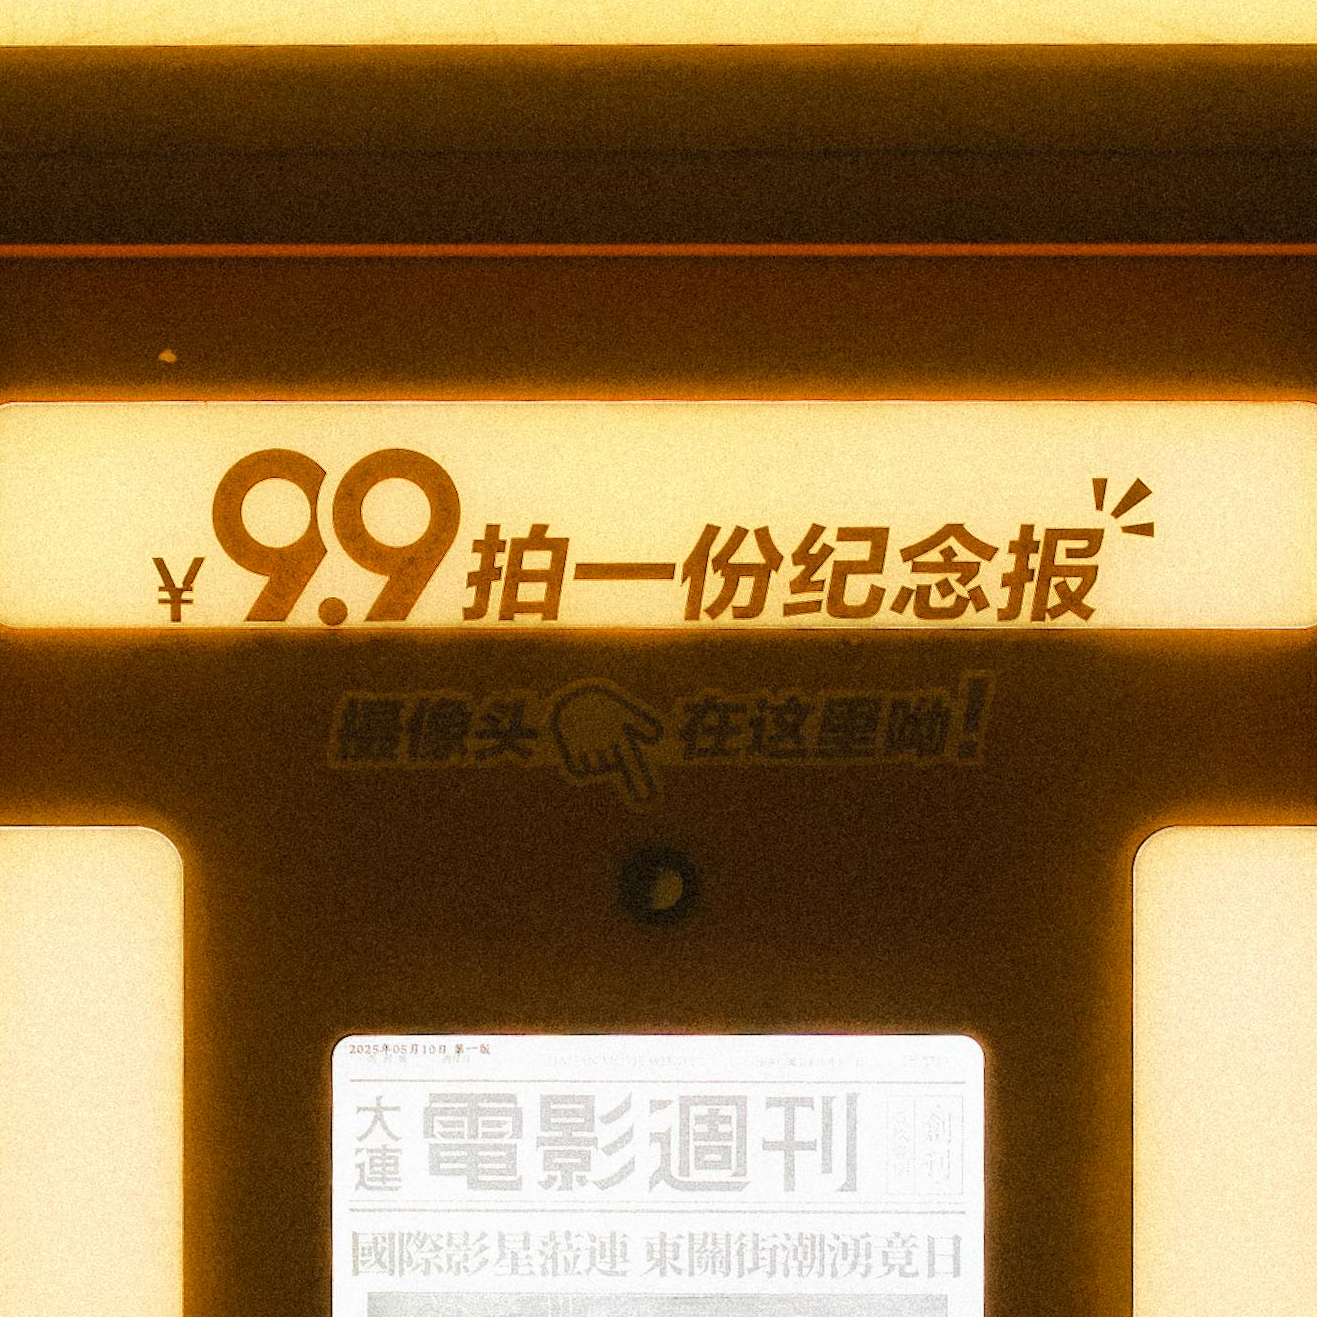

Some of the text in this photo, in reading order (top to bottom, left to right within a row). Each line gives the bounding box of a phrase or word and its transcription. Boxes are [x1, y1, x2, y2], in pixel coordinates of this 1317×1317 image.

[335, 692, 541, 764] 摄像头
[349, 1043, 447, 1055] 2025年05月10日
[355, 1096, 402, 1191] 大連
[423, 1092, 859, 1193] 電影週刊
